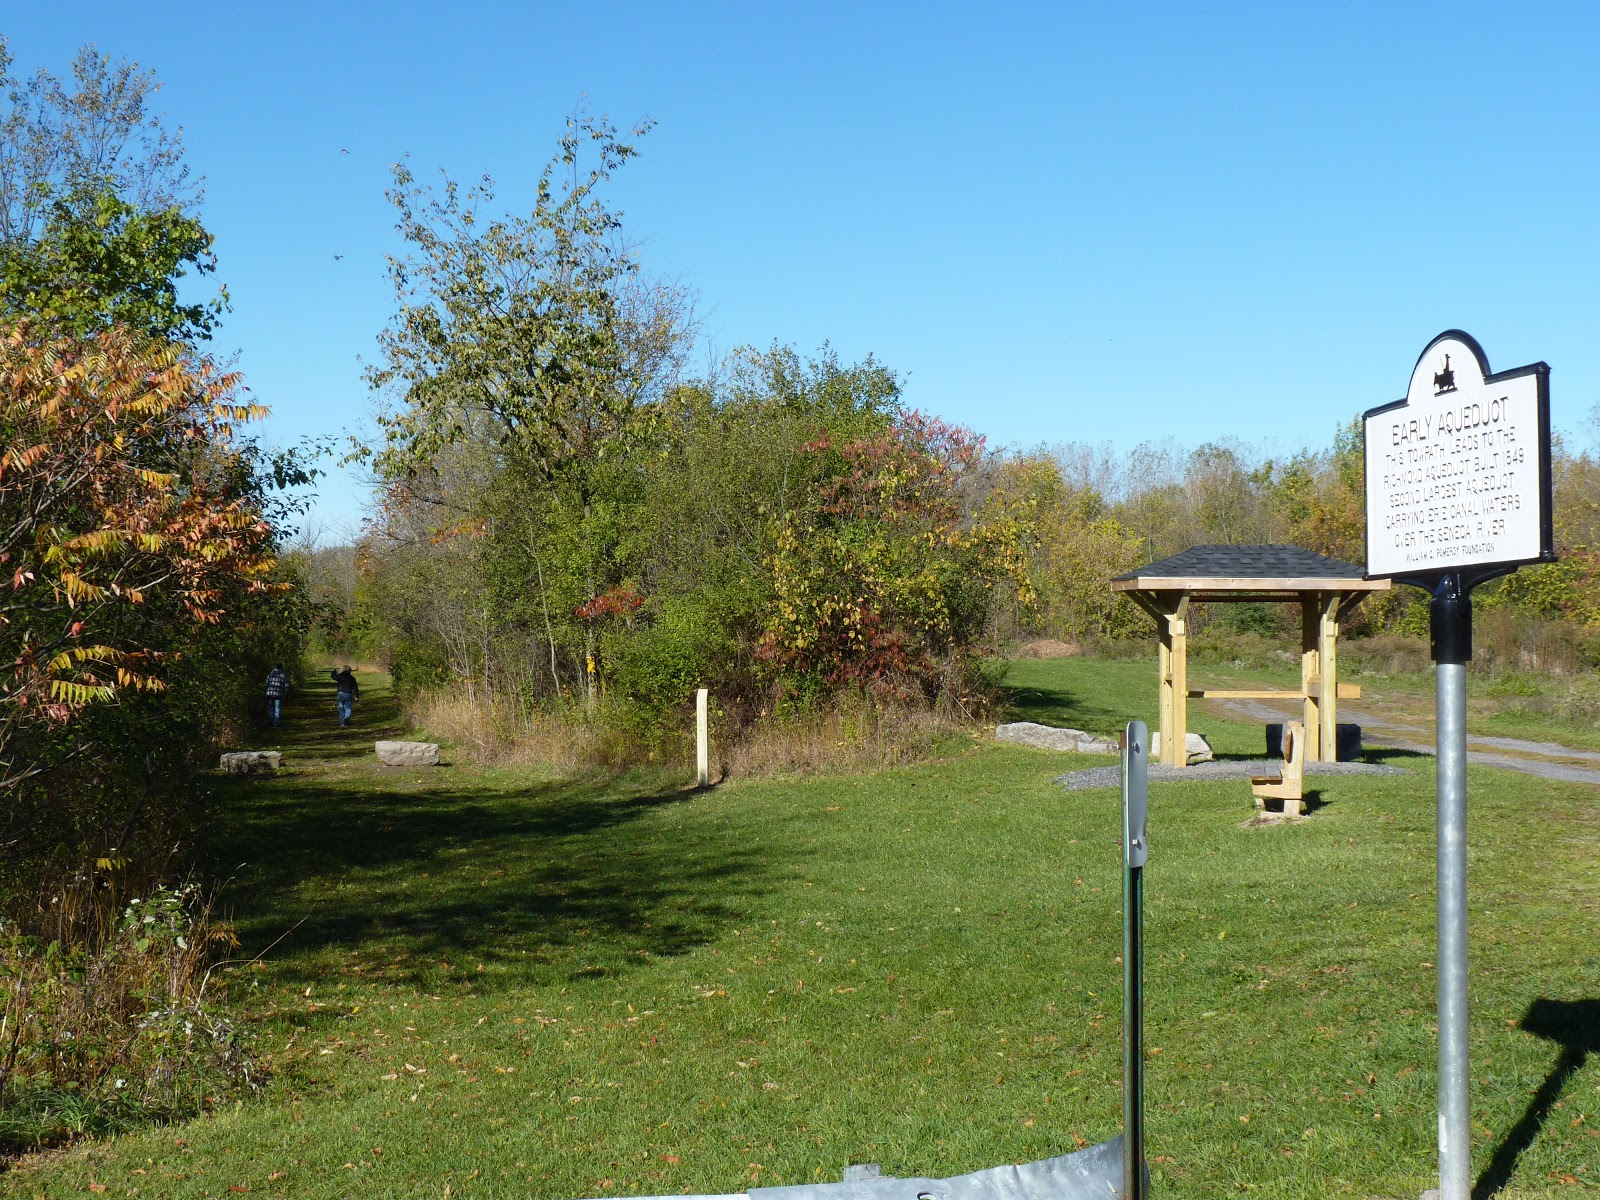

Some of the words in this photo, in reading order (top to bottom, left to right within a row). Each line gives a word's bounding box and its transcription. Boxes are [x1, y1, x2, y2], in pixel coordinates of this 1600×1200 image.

[1392, 414, 1432, 446] EARLY
[1438, 396, 1509, 436] AQUEDUCT
[1386, 452, 1404, 469] THIS
[1408, 443, 1445, 463] TOWPATH
[1450, 434, 1478, 454] LEADS
[1481, 431, 1493, 448] TO
[1497, 426, 1516, 444] THE
[1384, 468, 1422, 489] RICHMOND
[1426, 459, 1470, 481] AQUEDUCT
[1474, 453, 1499, 471] BUILT
[1503, 447, 1524, 466] 1849
[1390, 489, 1420, 508] SECOND
[1424, 481, 1462, 502] LARGEST
[1466, 472, 1515, 495] AQUEDUCT
[1386, 510, 1424, 529] CARRYING
[1428, 506, 1447, 522] ERIE
[1451, 501, 1478, 519] CANAL
[1482, 494, 1520, 515] WATERS
[1395, 531, 1416, 548] OVER
[1419, 529, 1435, 545] THE
[1438, 524, 1471, 542] SENECA
[1477, 519, 1505, 538] RIVER
[1406, 551, 1428, 562] WILLIAM
[1436, 546, 1460, 558] POMEROY
[1462, 542, 1495, 555] FOUNDATION
